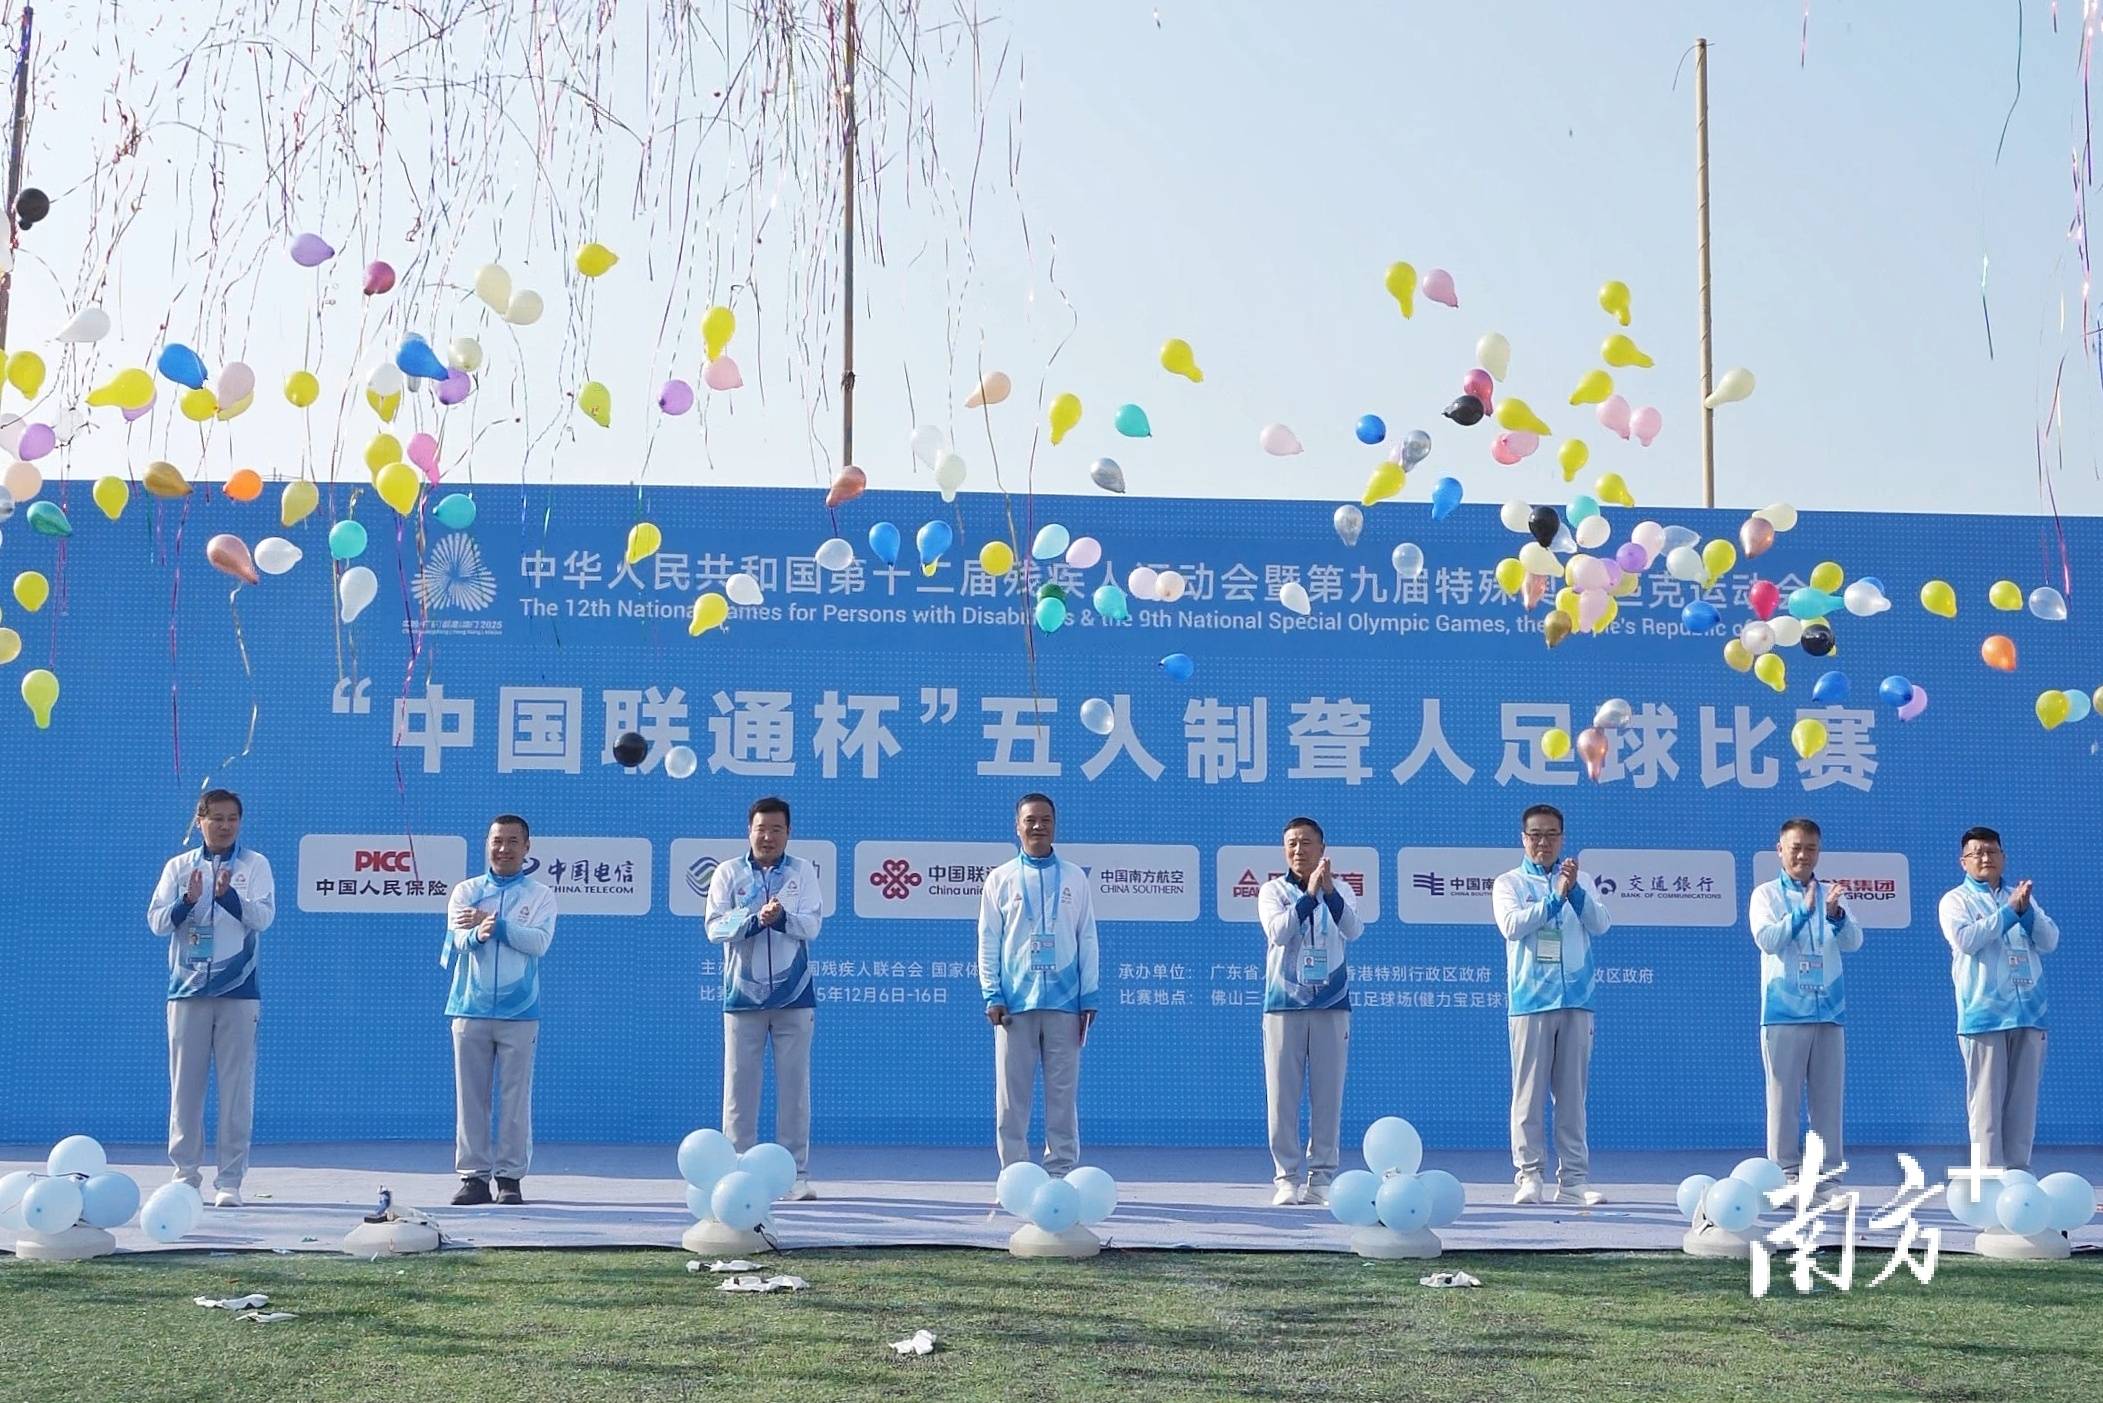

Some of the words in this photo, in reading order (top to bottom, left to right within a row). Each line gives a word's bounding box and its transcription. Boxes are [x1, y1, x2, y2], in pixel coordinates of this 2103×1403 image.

[520, 598, 559, 617] The
[566, 599, 610, 617] 12th
[618, 599, 694, 619] Nationa
[728, 603, 782, 621] ames
[788, 602, 816, 621] for
[823, 605, 906, 623] Persons
[913, 605, 955, 623] with
[1081, 609, 1095, 626] &
[1139, 610, 1170, 628] 9th
[1178, 610, 1262, 629] National
[1269, 612, 1341, 633] Special
[1349, 613, 1429, 635] Olympic
[1435, 614, 1510, 636] Games,
[355, 850, 411, 872] PICC
[547, 858, 635, 885] 中国电信
[1100, 869, 1185, 885] 中国南方航空
[316, 879, 448, 896] 中国人民保险
[549, 885, 581, 894] HINA
[584, 886, 634, 894] TELECOM
[929, 885, 961, 896] China
[1100, 884, 1130, 894] CHINA
[1132, 884, 1185, 895] SOUTHERN
[1657, 892, 1722, 900] COMMUNICATIONS
[1843, 891, 1896, 901] GROUP
[1210, 963, 1266, 981] 广东省
